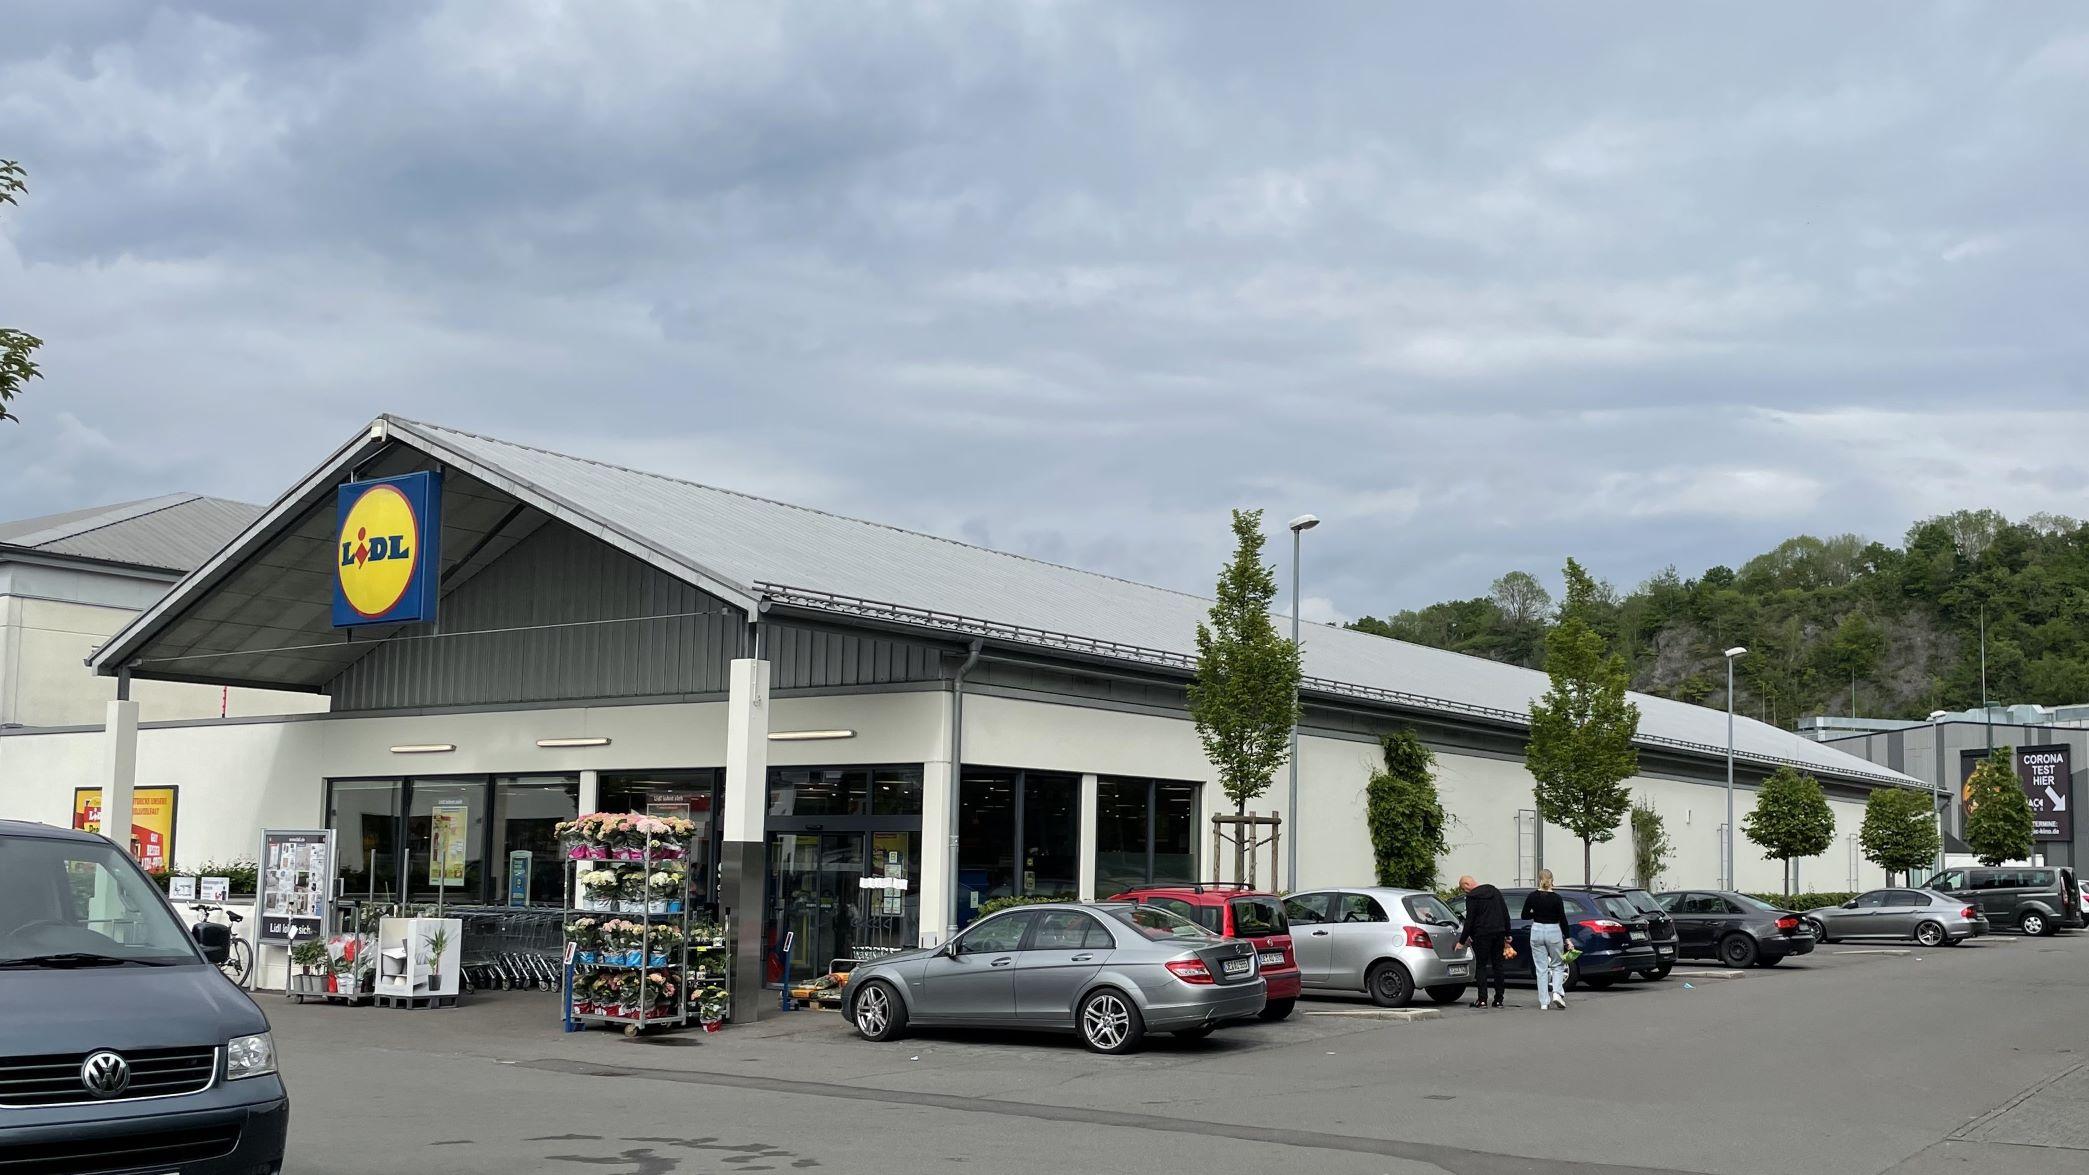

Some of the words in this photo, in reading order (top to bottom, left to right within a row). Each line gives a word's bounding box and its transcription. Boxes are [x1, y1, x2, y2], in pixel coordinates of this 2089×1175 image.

[2023, 754, 2064, 765] CORONA
[2032, 765, 2055, 775] TEST
[2033, 776, 2055, 786] HIER
[270, 922, 281, 933] Lidl
